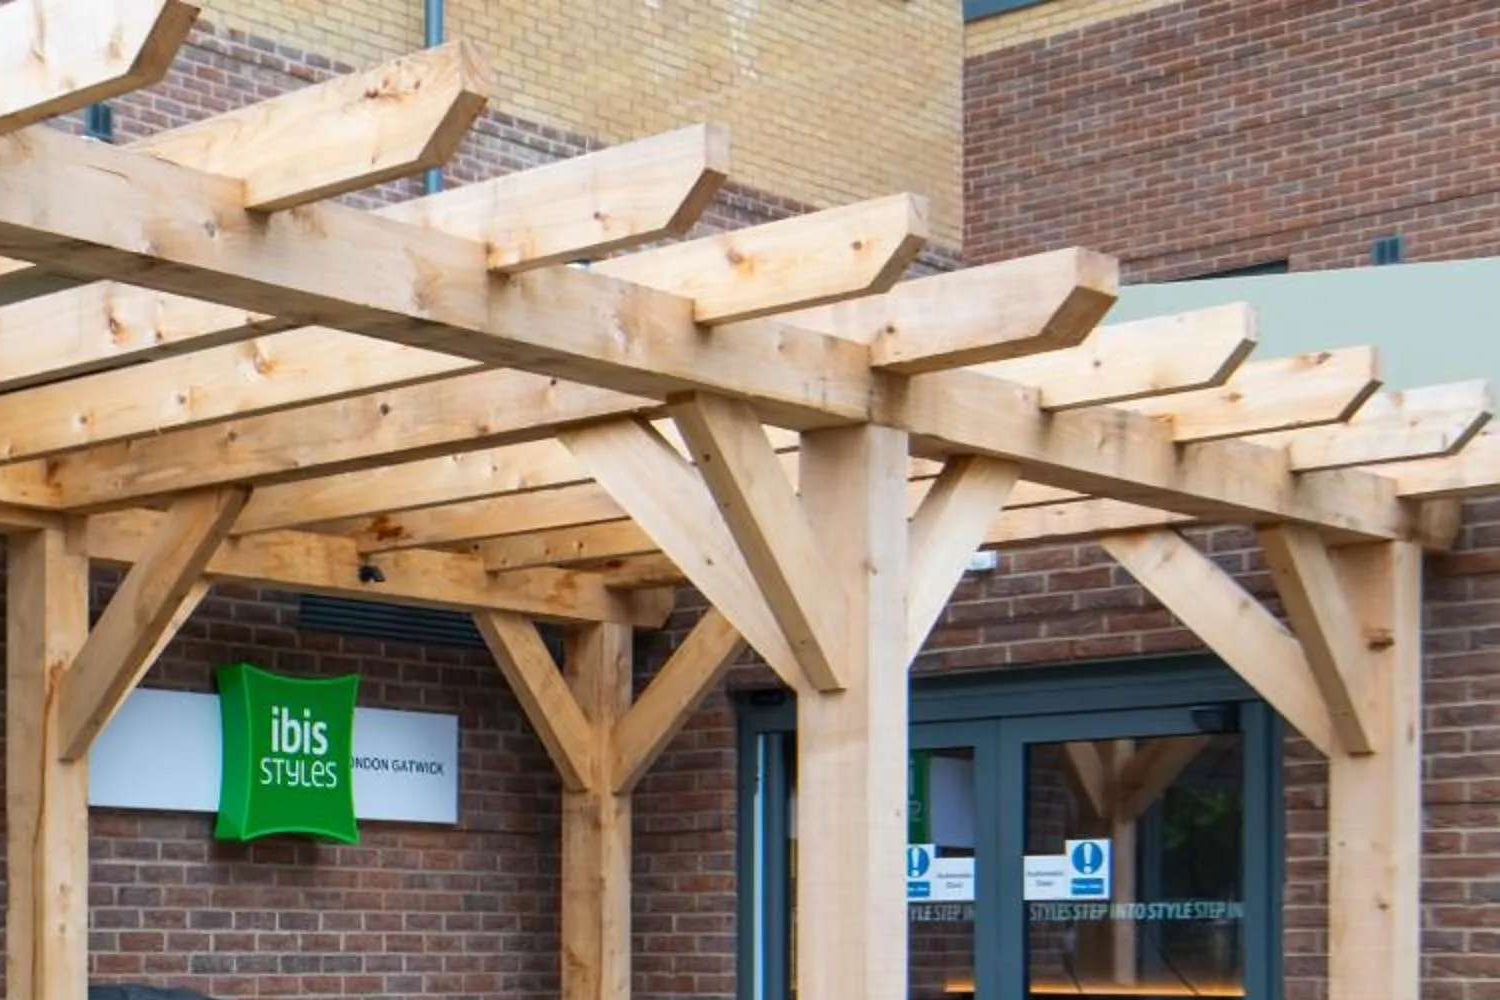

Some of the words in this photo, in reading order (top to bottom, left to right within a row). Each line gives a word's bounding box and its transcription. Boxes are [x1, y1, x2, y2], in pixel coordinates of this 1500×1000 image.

[270, 705, 328, 756] ibis
[391, 759, 444, 776] GATWICK
[1073, 903, 1108, 920] STEP
[1110, 903, 1146, 920] INTO
[1147, 902, 1193, 919] STYLE
[1195, 901, 1225, 918] STEP
